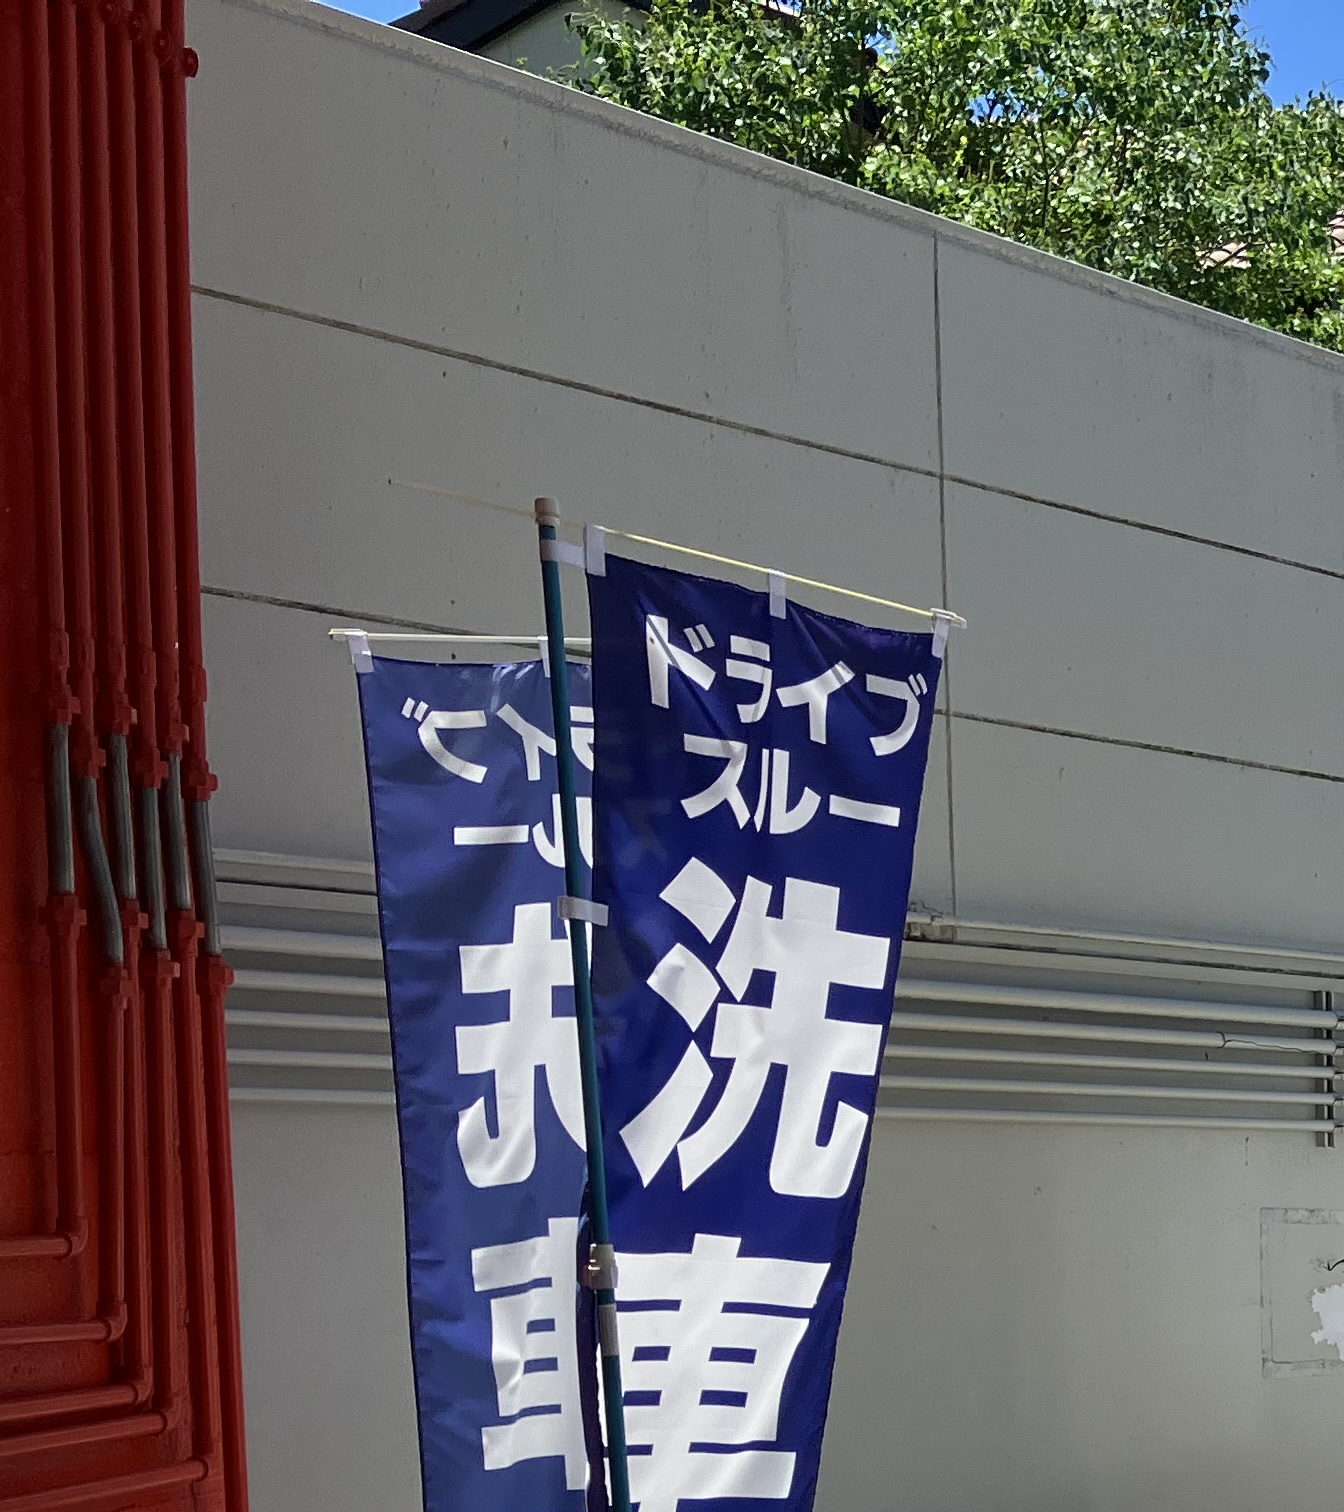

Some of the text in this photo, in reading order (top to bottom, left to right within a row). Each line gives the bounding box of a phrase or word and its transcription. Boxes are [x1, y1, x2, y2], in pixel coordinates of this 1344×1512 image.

[645, 614, 928, 757] ドライブ
[681, 733, 900, 834] スルー
